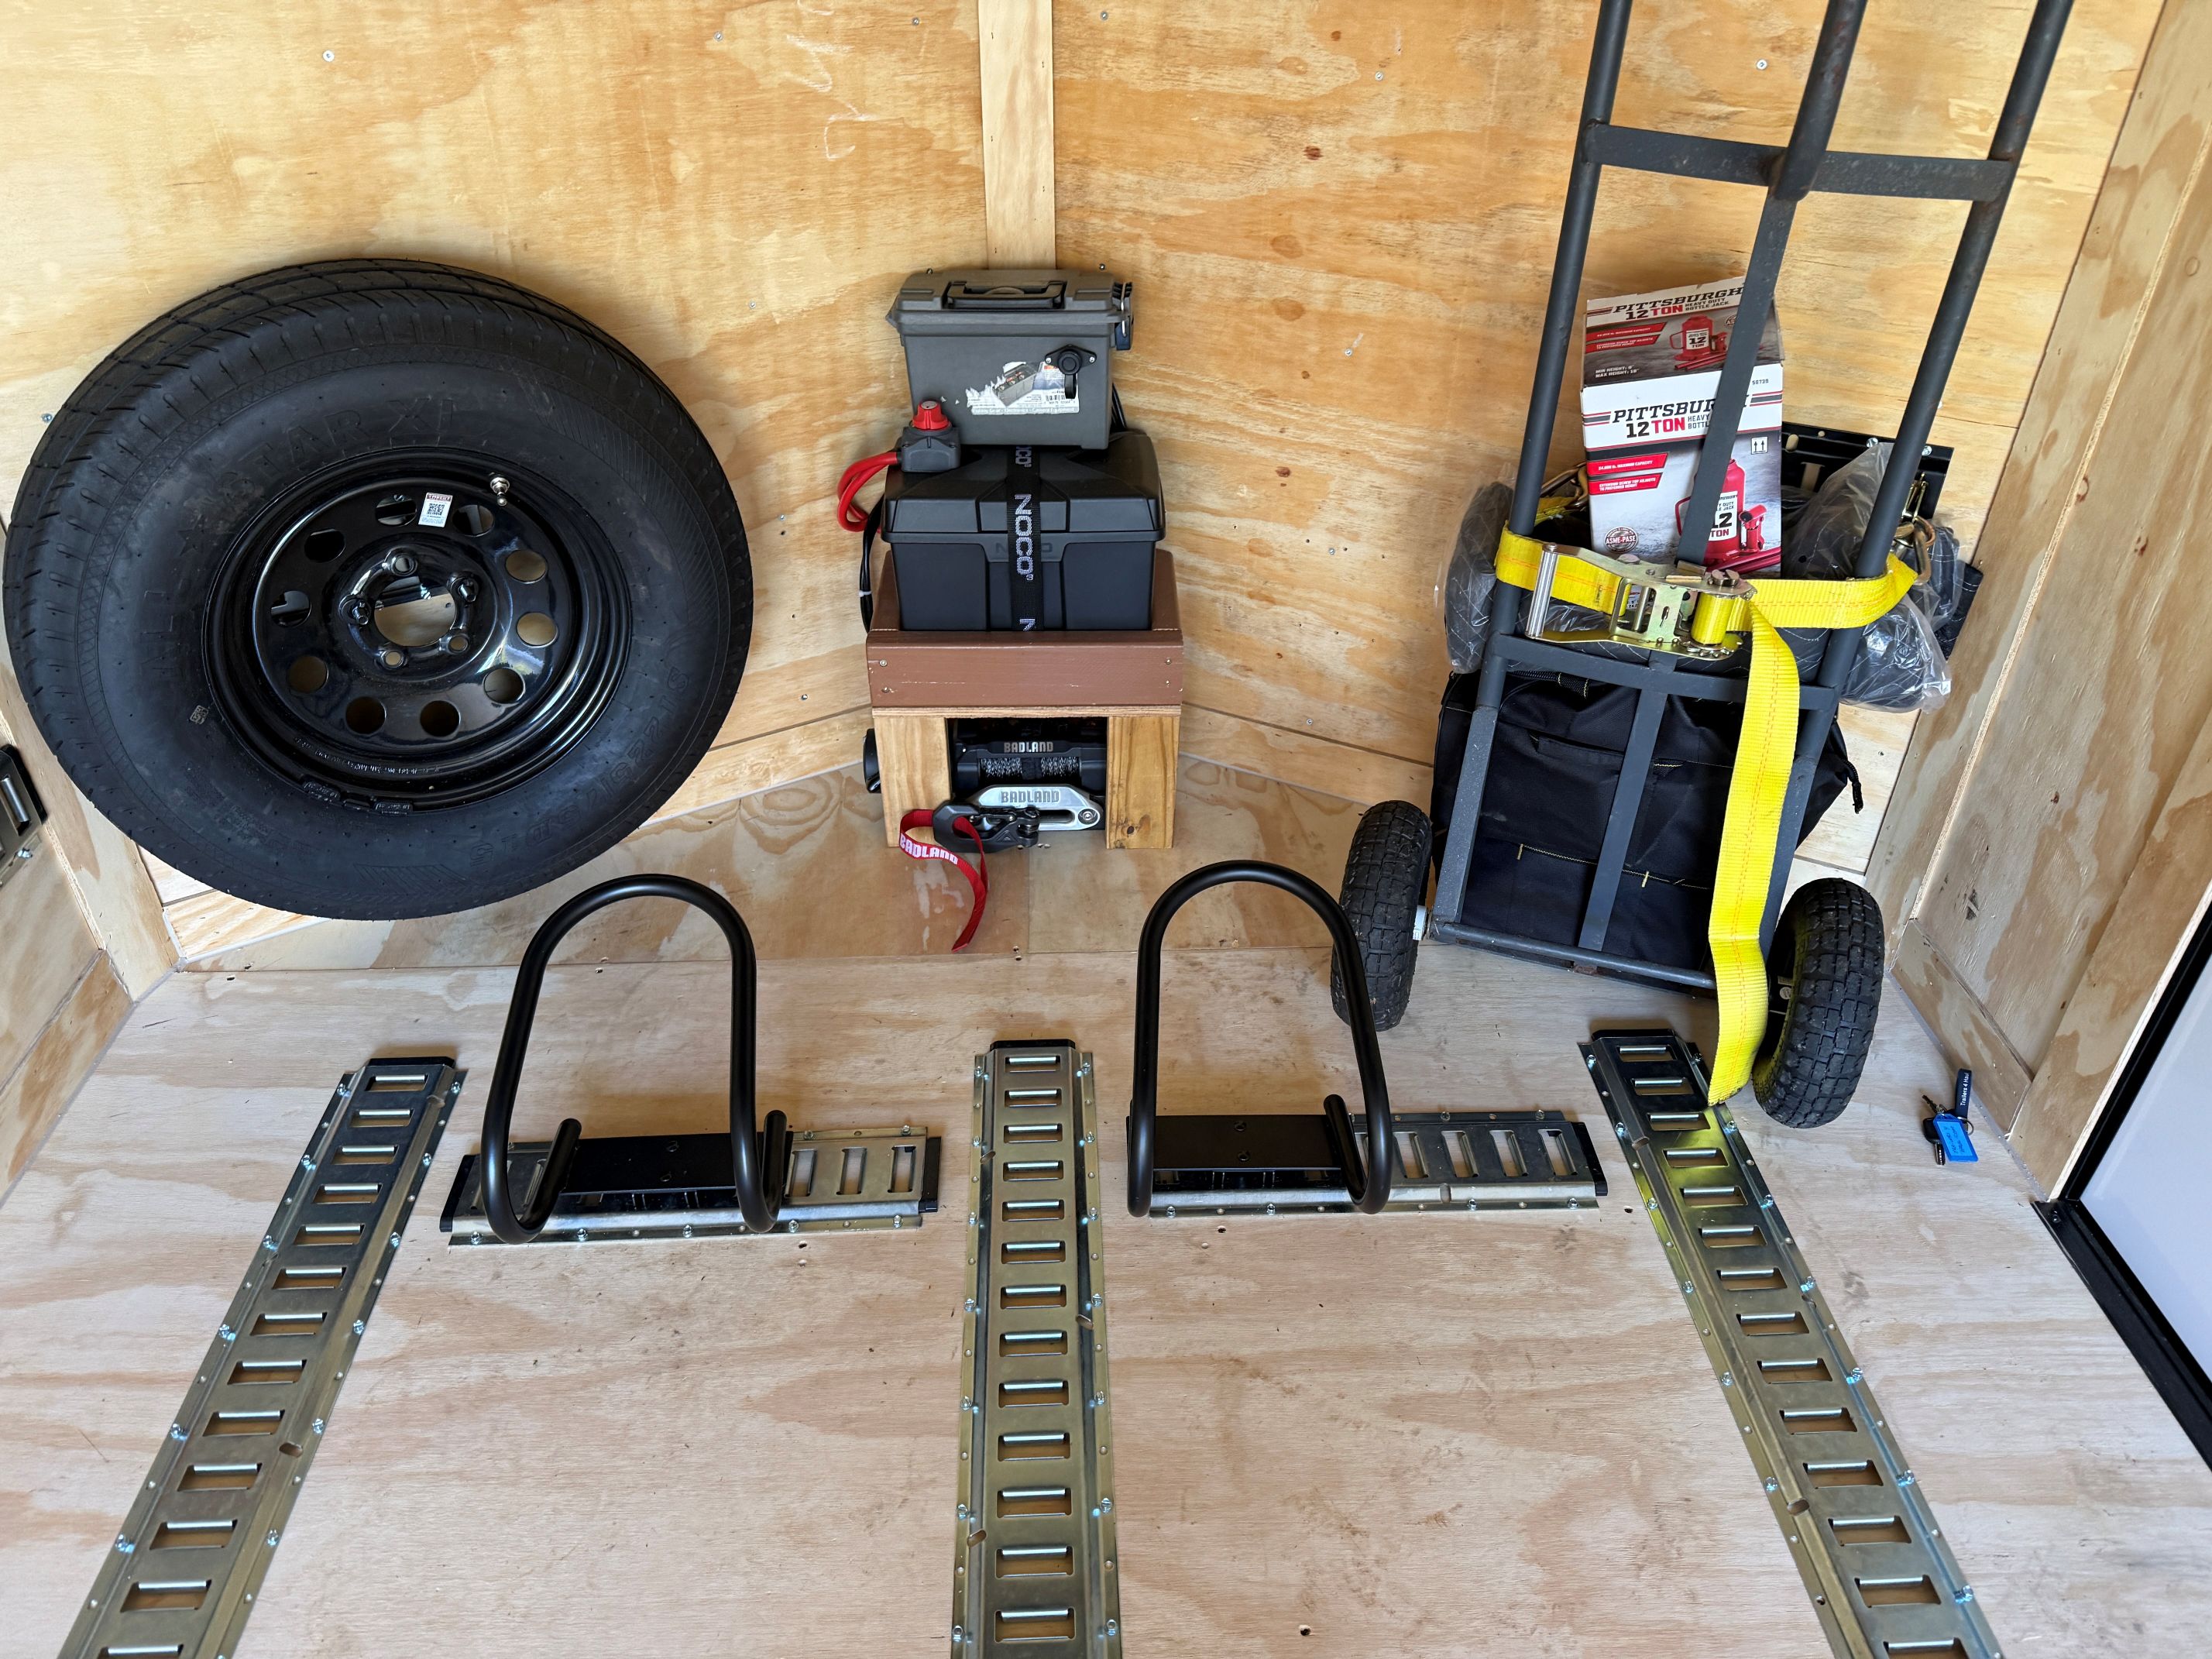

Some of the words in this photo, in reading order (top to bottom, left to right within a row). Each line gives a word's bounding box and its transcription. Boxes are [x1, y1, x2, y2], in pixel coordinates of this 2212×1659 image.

[1613, 287, 1744, 313] PITTSBURGH
[1626, 309, 1648, 320] 12
[1650, 305, 1683, 316] TON
[1689, 336, 1707, 345] 12
[1613, 394, 1749, 423] PITTSBUR
[1626, 421, 1650, 438] 12
[1651, 417, 1686, 434] TON
[1606, 535, 1636, 544] ASME-PASE
[1711, 529, 1729, 538] TON
[1004, 741, 1053, 753] BADLAND
[1001, 790, 1060, 803] BADLAND
[900, 833, 958, 865] BADLAND
